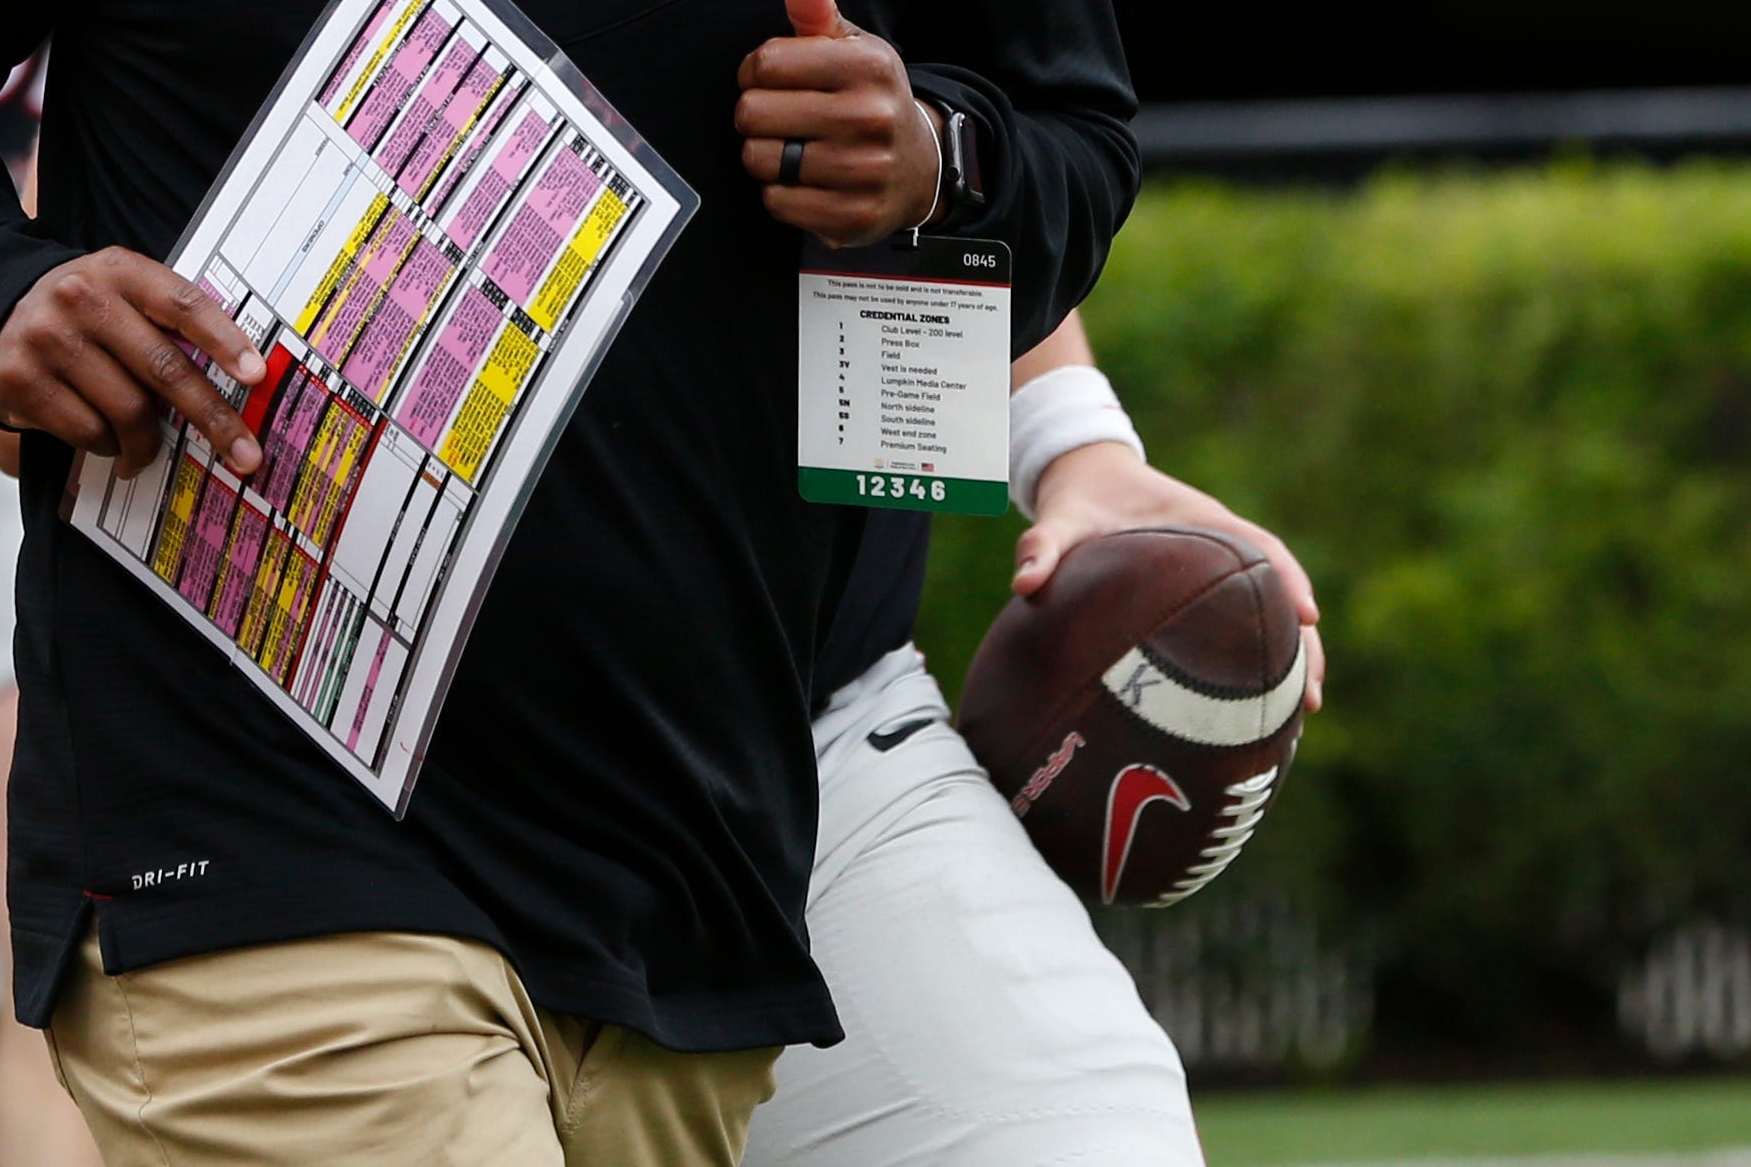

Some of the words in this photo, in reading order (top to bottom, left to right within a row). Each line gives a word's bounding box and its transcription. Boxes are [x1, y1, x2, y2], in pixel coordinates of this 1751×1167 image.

[963, 254, 996, 268] 0845
[860, 310, 917, 322] CREDENTIAL
[920, 314, 950, 324] ZONES
[882, 325, 899, 334] Club
[901, 327, 921, 335] Level
[929, 329, 943, 337] 200
[945, 330, 963, 338] level
[882, 338, 903, 347] Press
[905, 339, 920, 348] Box
[882, 351, 901, 360] Field
[882, 364, 898, 372] Vest
[900, 365, 907, 373] is
[909, 367, 938, 375] needed
[881, 377, 915, 387] Lumpkin
[916, 379, 939, 388] Media
[941, 381, 967, 390] Center
[881, 389, 920, 399] Pre-Game
[921, 392, 941, 401] Field
[881, 403, 903, 411] North
[905, 404, 935, 413] sideline
[881, 415, 904, 423] South
[906, 417, 936, 426] sideline
[881, 428, 900, 436] West
[902, 430, 917, 438] end
[881, 440, 916, 450] Premium
[917, 443, 947, 455] Seating
[1119, 663, 1162, 707] K
[131, 859, 210, 890] DRI-FIT
